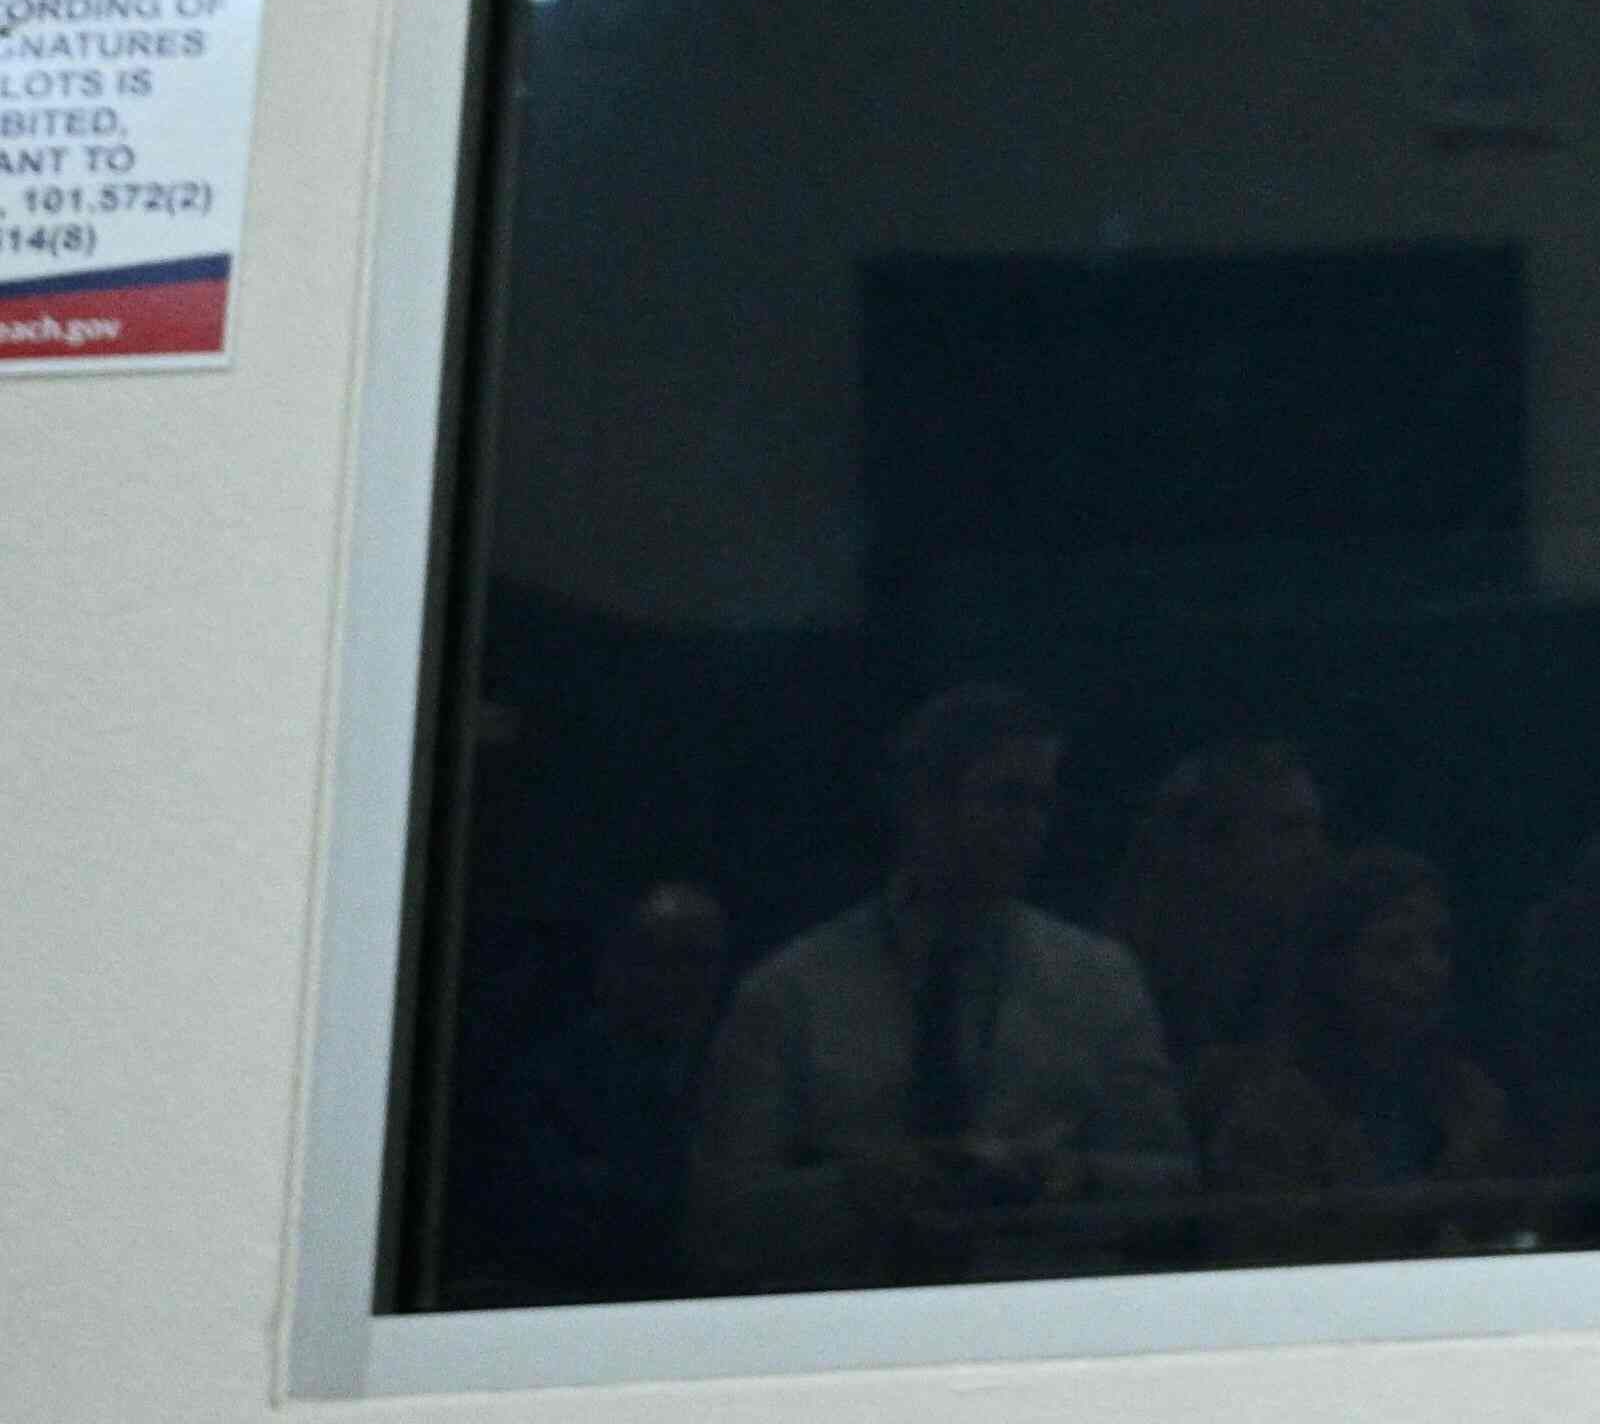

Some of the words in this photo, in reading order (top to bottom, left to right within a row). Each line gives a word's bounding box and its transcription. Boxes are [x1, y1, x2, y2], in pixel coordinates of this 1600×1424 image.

[117, 68, 152, 95] IS
[86, 145, 135, 173] TO
[24, 181, 213, 217] 101.572(2)
[0, 224, 97, 257] 14(8)
